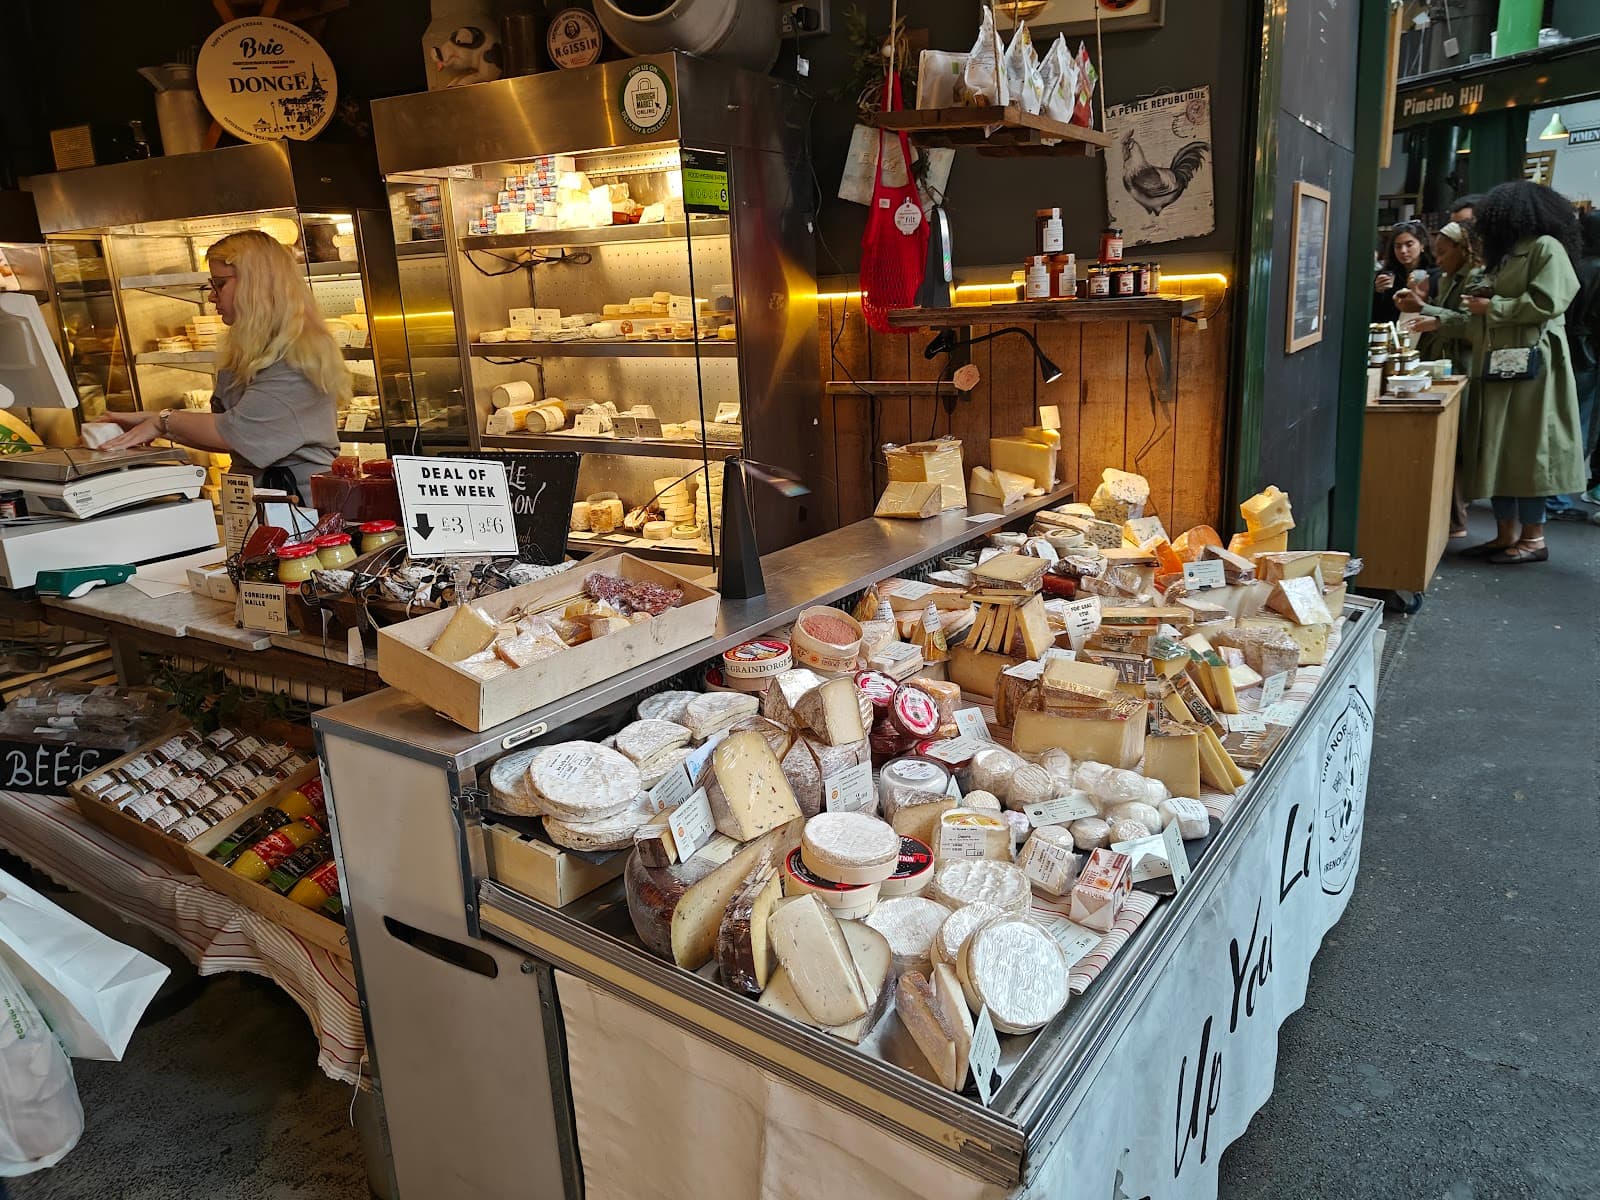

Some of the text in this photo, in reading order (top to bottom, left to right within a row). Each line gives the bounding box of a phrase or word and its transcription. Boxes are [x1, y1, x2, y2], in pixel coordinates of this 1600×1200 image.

[240, 37, 285, 58] Brie
[628, 66, 641, 78] FIND
[649, 65, 659, 73] ON
[1403, 84, 1484, 117] Pimento Hill
[1104, 108, 1117, 119] LA
[1119, 102, 1148, 116] PETITE
[421, 467, 486, 480] DEAL OF
[417, 484, 496, 498] THE WEEK
[441, 517, 464, 534] £3
[244, 591, 281, 601] CORNICHONS
[730, 658, 788, 674] GRAINDORGE
[1174, 1015, 1222, 1179] Up
